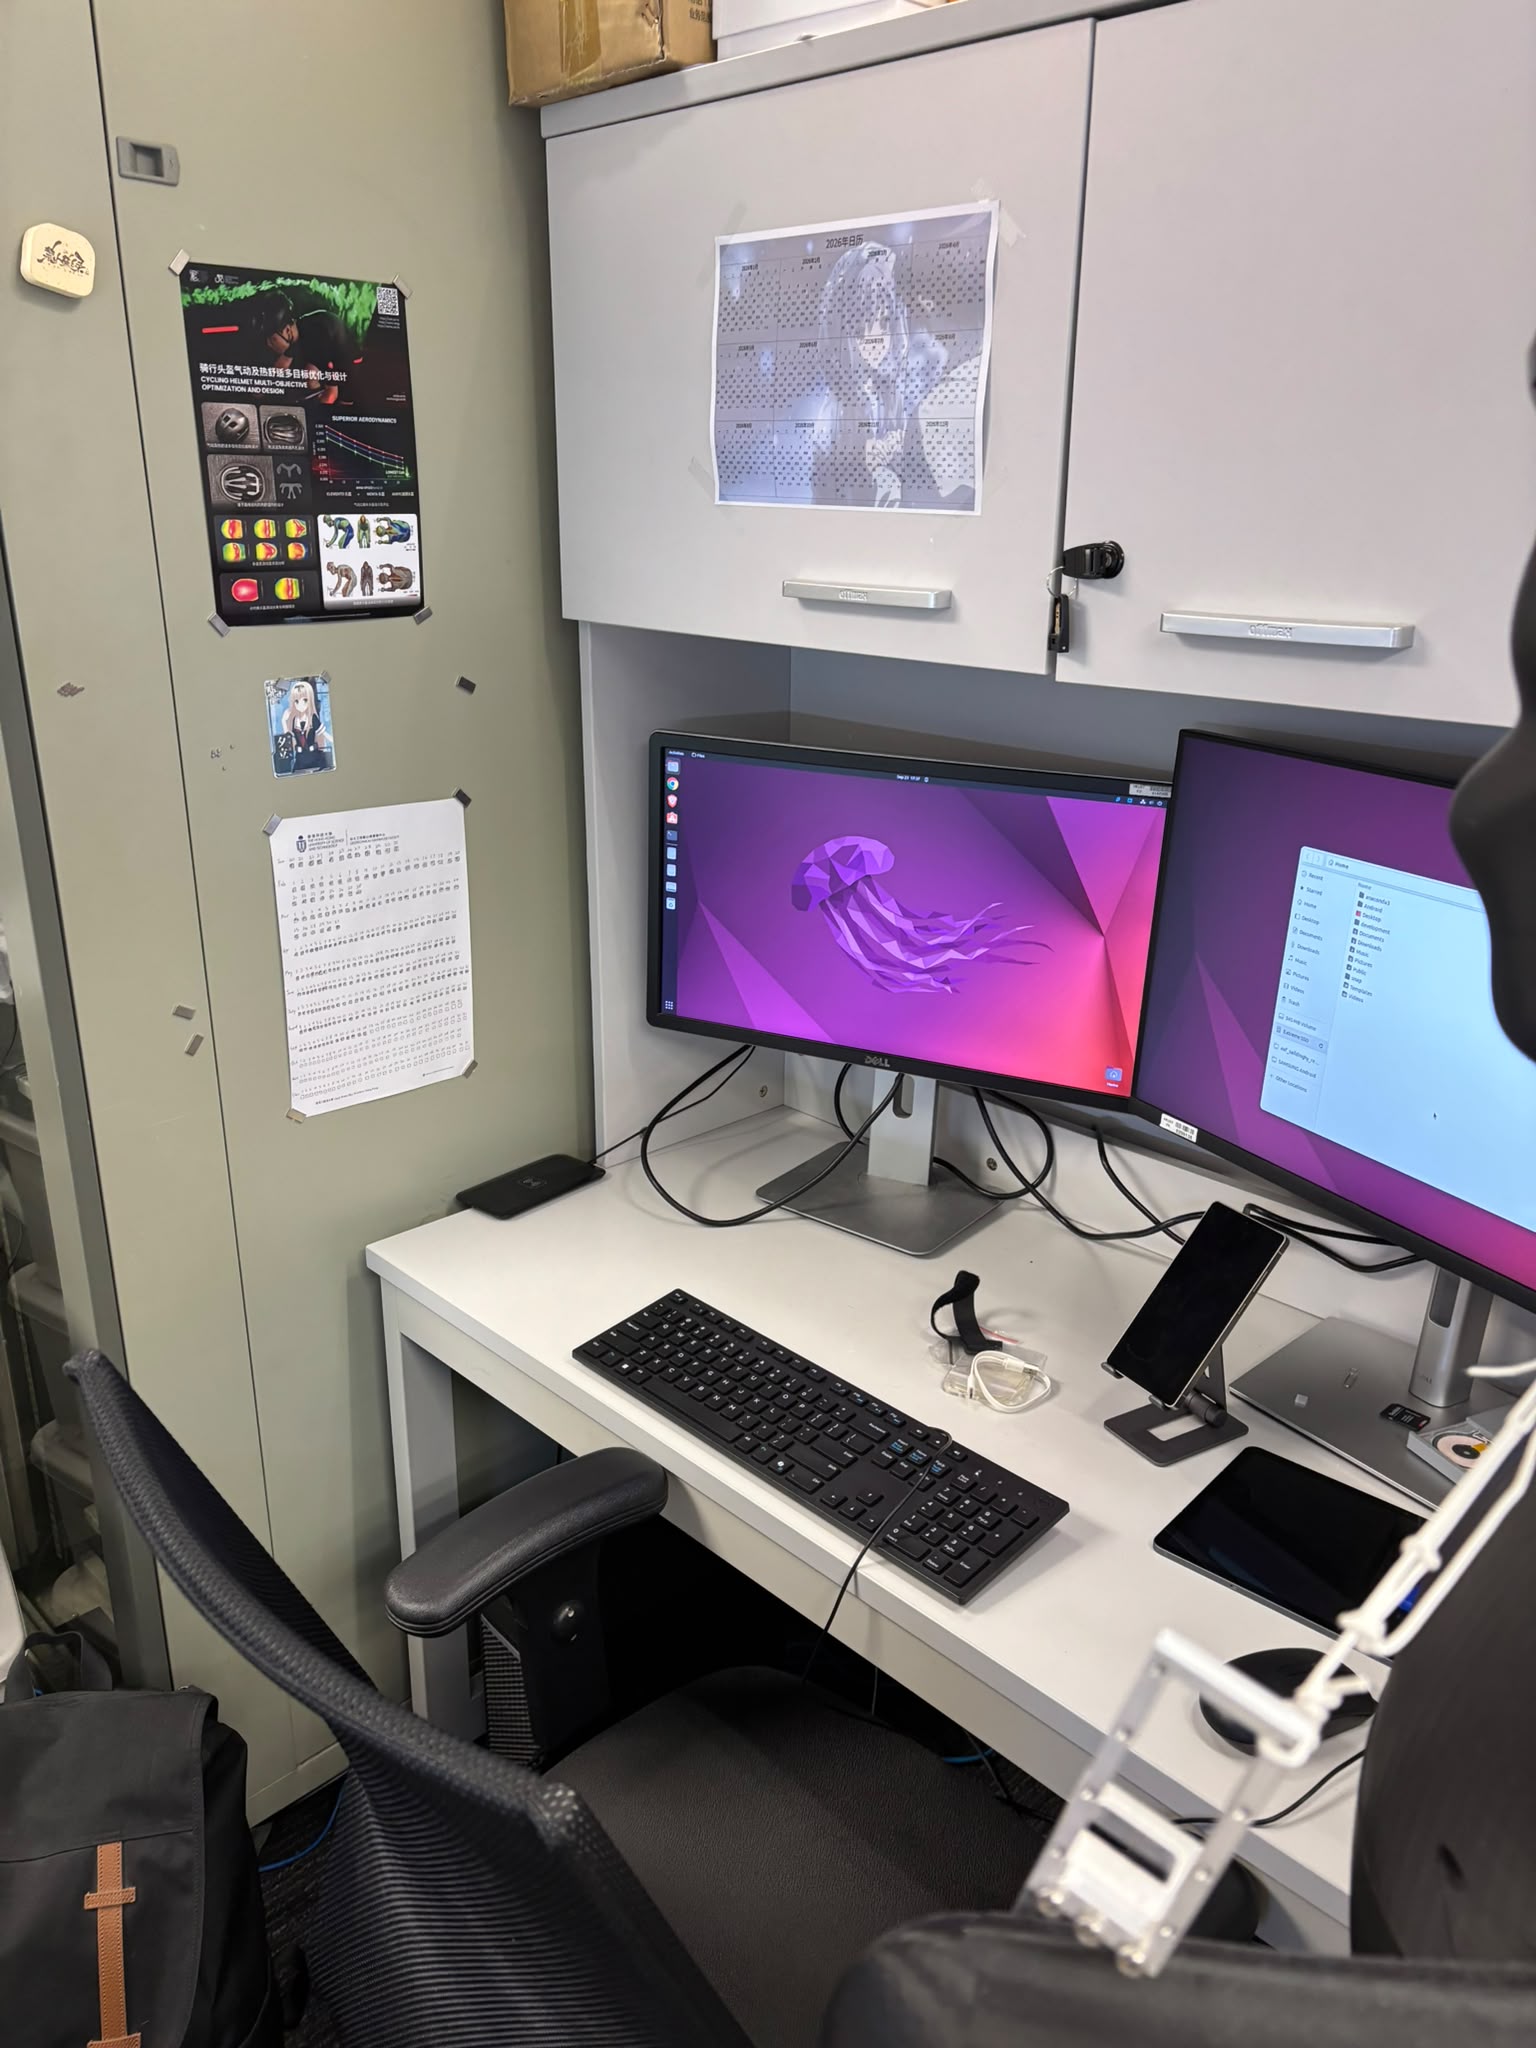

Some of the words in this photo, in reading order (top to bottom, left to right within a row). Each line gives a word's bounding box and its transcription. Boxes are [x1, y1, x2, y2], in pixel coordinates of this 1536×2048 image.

[826, 234, 864, 249] 2026年日历
[199, 362, 348, 382] 骑行头盔气动及热舒适多目标优化与设计
[201, 376, 229, 384] CYCLING
[230, 377, 253, 385] HELMET
[254, 378, 308, 388] MULTI-OBJECTIVE
[202, 384, 246, 393] OPTIMIZATION
[1301, 915, 1320, 925] Desktop
[1362, 912, 1381, 923] Desktop
[1299, 929, 1323, 942] Documents
[1359, 930, 1384, 942] Documents
[1357, 939, 1382, 952] Downloads
[1354, 957, 1373, 968] Pictures
[1292, 971, 1310, 982] Pictures
[864, 1055, 890, 1067] DELL
